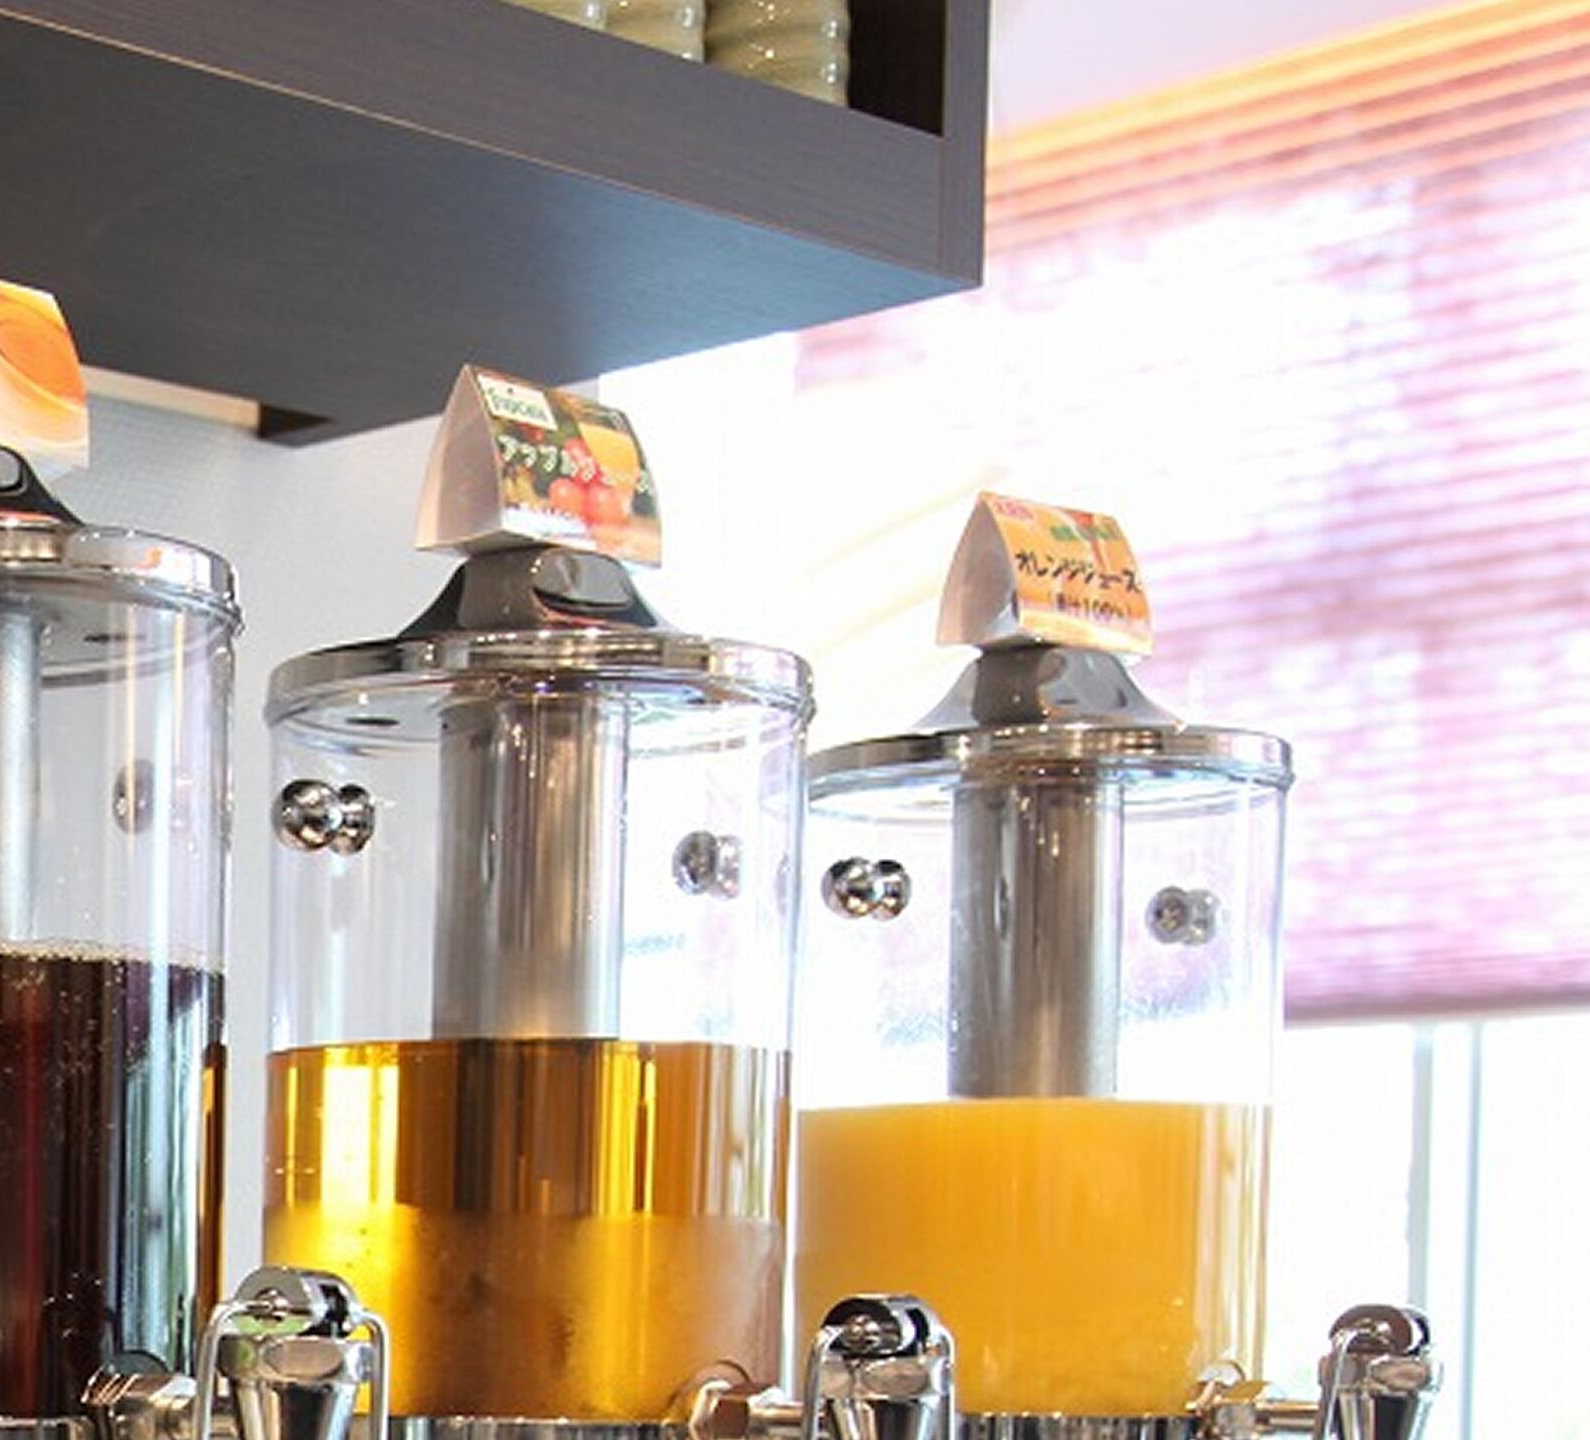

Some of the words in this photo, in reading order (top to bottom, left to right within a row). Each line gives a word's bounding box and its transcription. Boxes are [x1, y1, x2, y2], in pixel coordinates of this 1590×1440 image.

[1014, 550, 1143, 593] オレンジジュース
